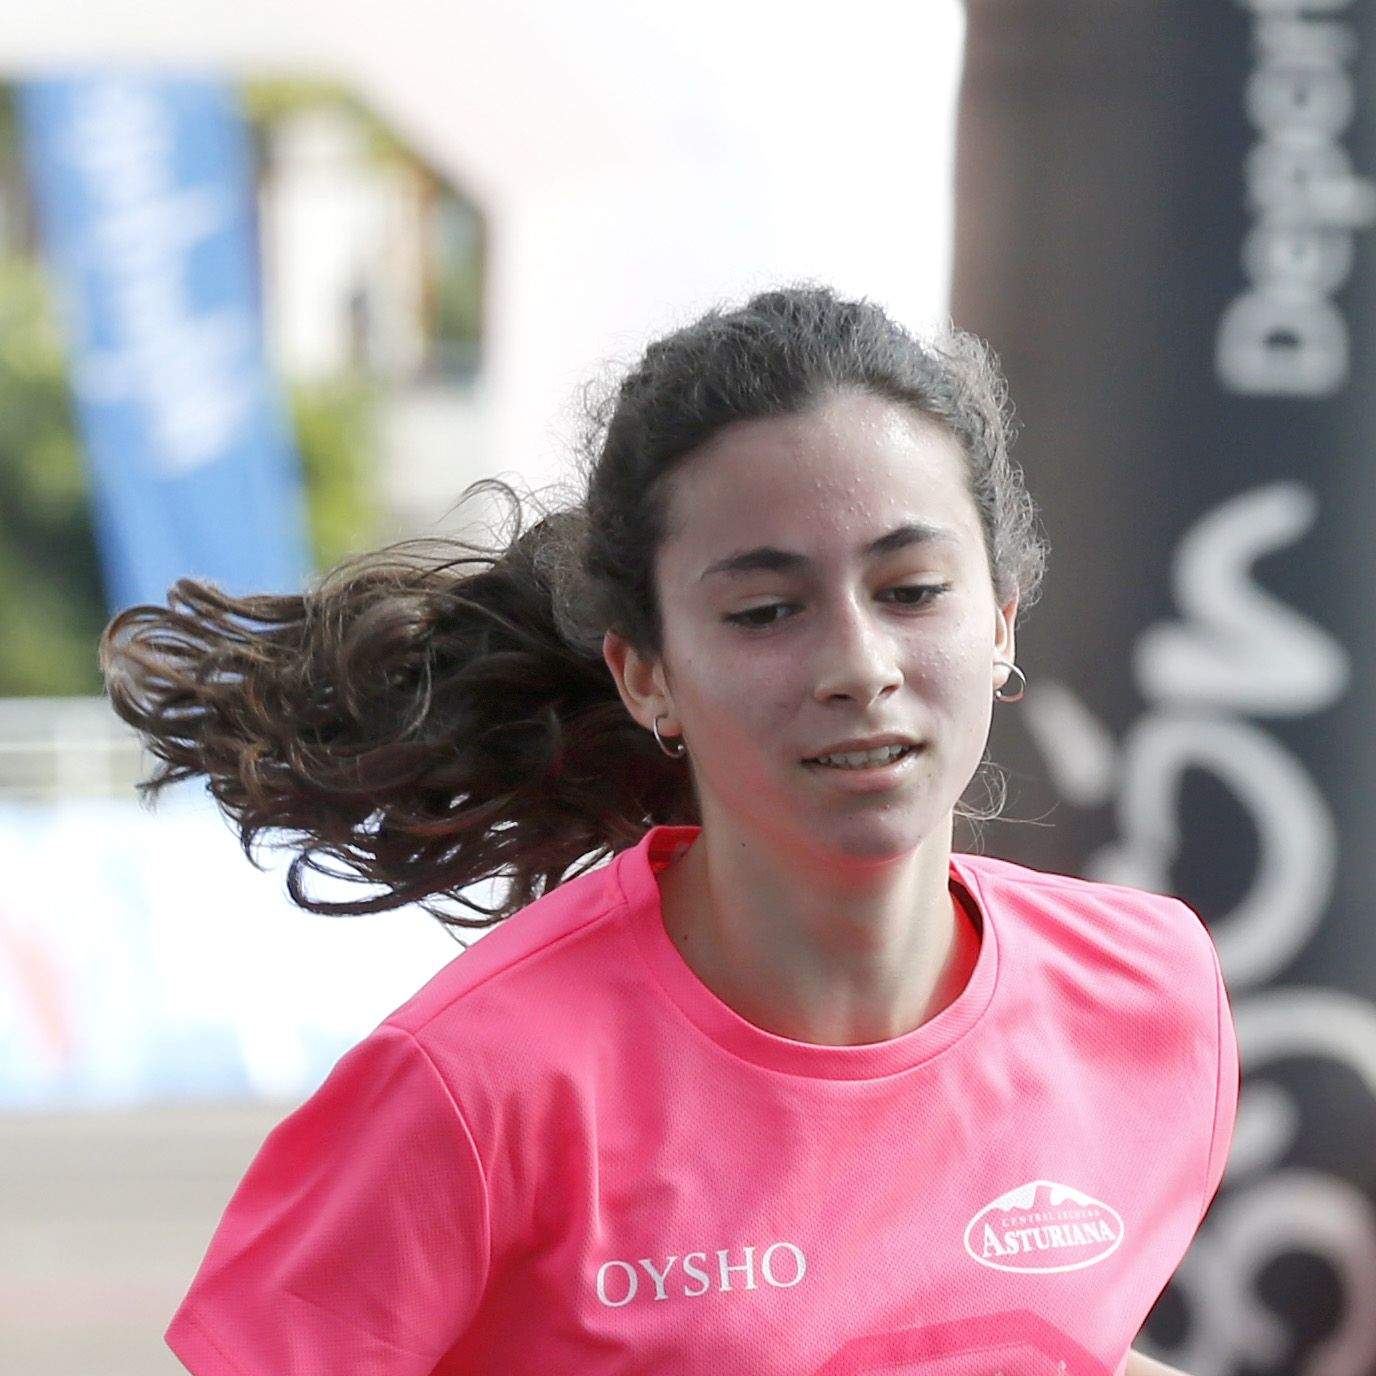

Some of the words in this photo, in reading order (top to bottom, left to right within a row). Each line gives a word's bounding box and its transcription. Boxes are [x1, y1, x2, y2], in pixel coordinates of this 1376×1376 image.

[1002, 1211, 1057, 1228] CENTRAL
[982, 1220, 1115, 1257] ASTURIANA
[596, 1241, 806, 1307] OYSHO
